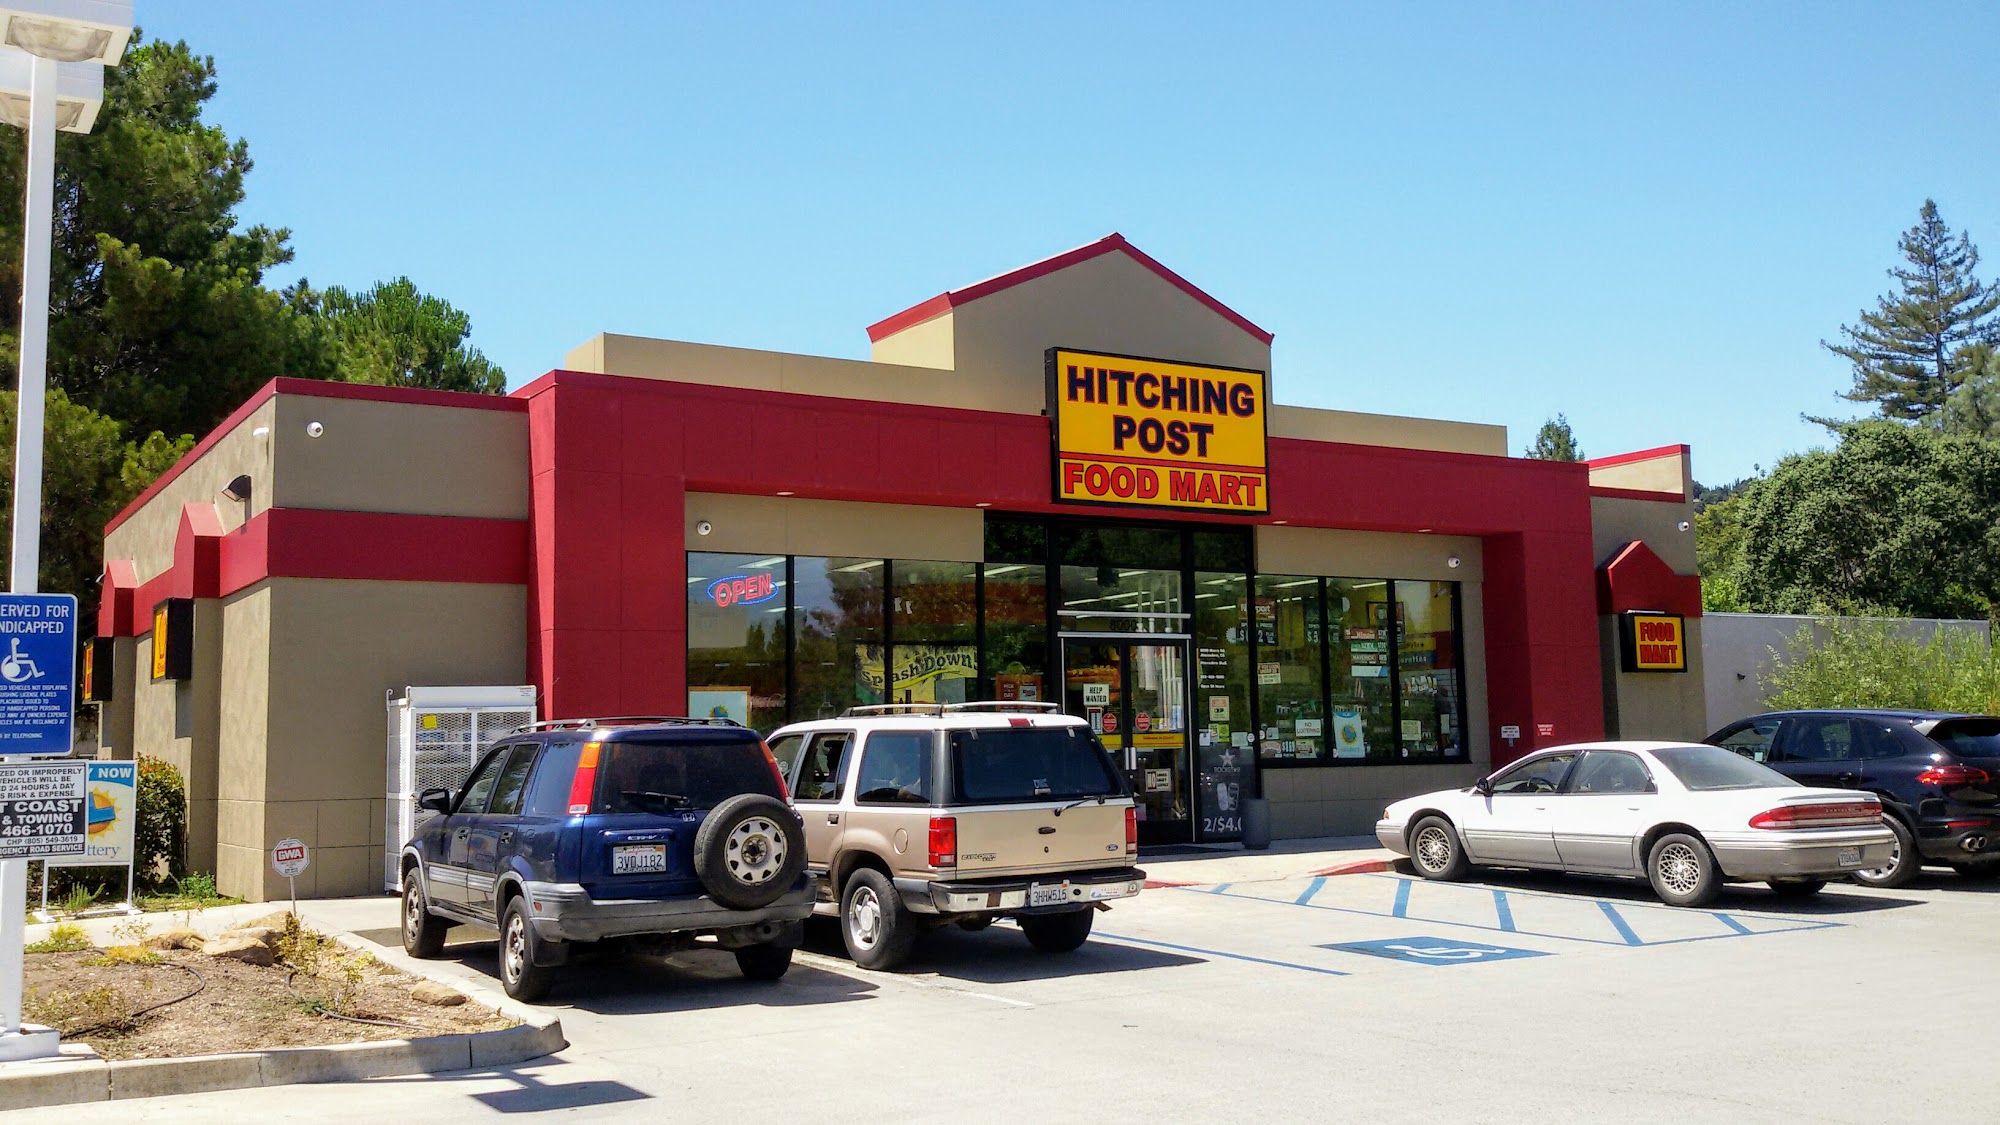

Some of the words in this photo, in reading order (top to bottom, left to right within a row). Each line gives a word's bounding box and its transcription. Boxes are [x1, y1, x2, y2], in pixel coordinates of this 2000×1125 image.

[1067, 364, 1255, 418] HITCHING
[1113, 415, 1214, 458] POST
[1064, 462, 1159, 499] FOOD
[1170, 471, 1261, 506] MART
[716, 574, 771, 607] OPEN
[46, 605, 69, 618] FOR
[1640, 622, 1674, 641] FOOD
[1640, 645, 1677, 663] MART
[861, 662, 919, 686] Spash
[99, 767, 132, 778] NOW
[14, 799, 82, 813] COAST
[2, 816, 12, 825] &
[17, 813, 73, 824] TOWING
[2, 823, 73, 836] 466-1070
